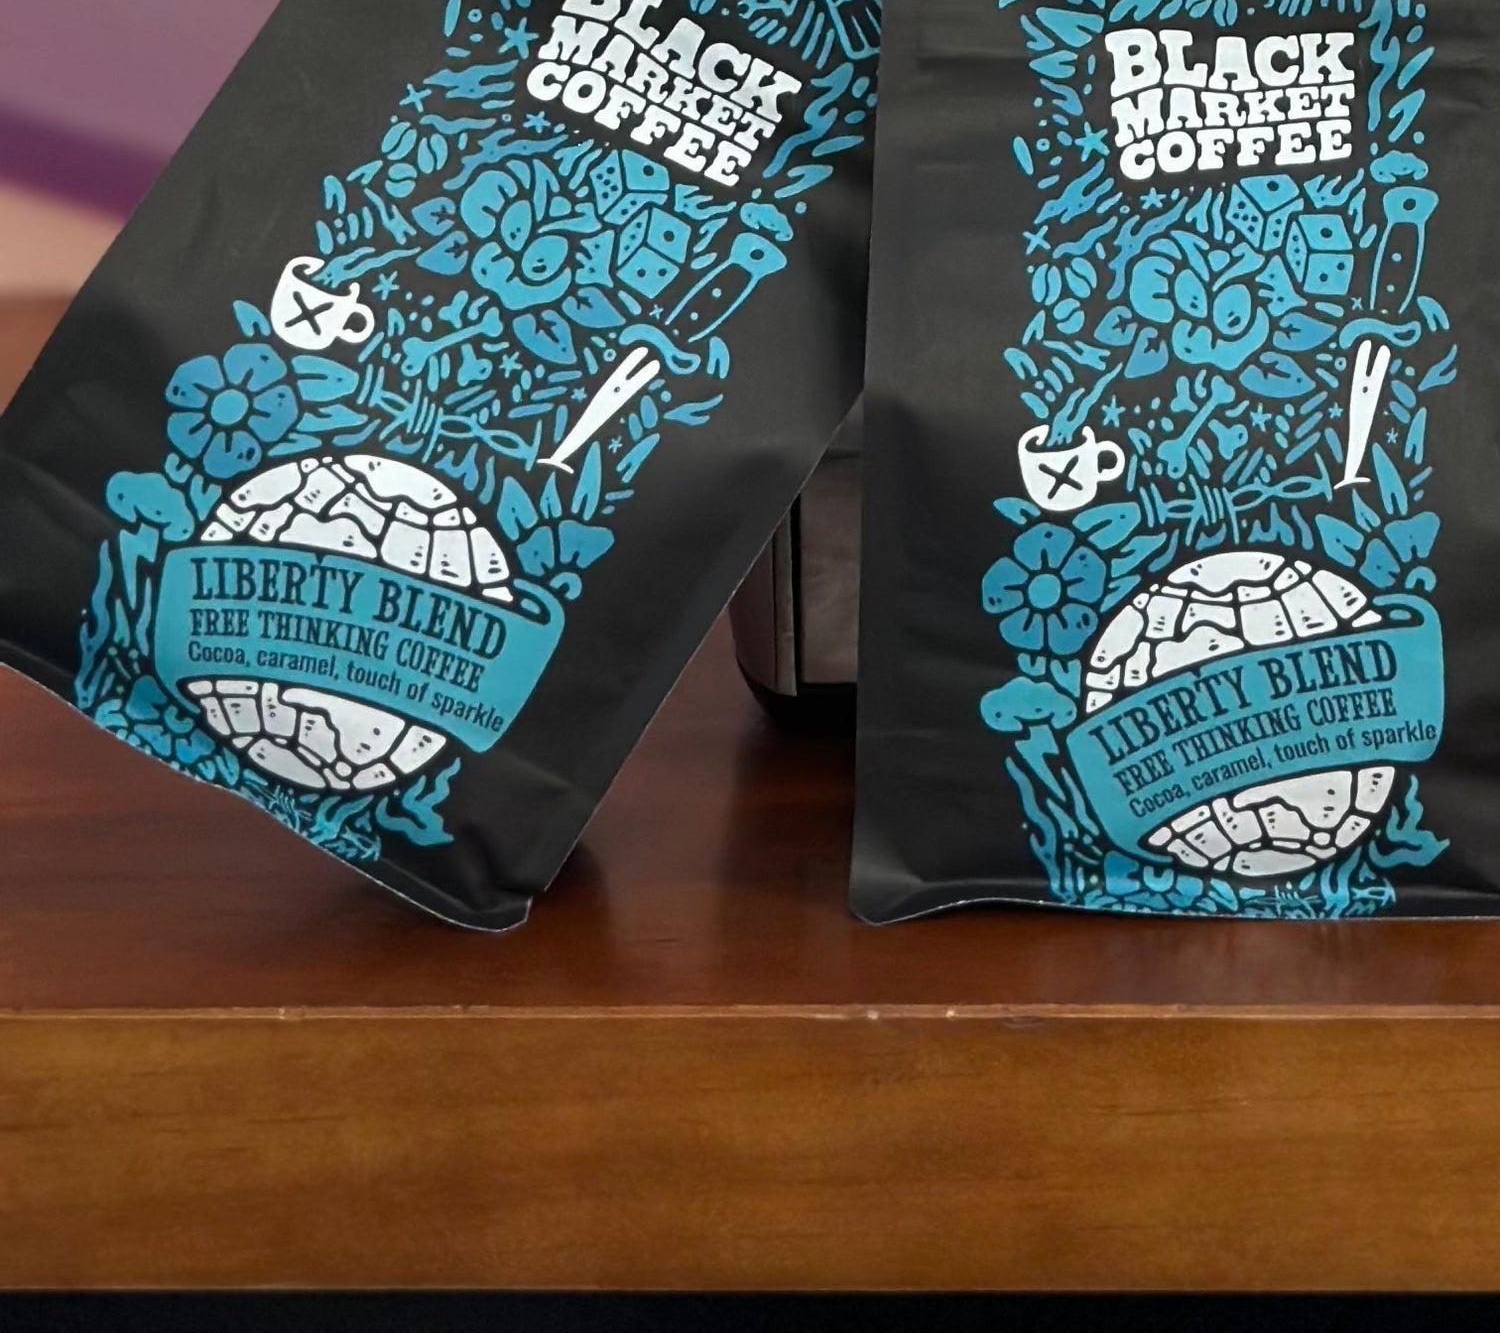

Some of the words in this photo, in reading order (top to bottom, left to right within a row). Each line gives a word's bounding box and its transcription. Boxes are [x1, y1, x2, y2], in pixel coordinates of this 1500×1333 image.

[538, 15, 776, 151] MARKET
[1104, 28, 1355, 97] BLACK
[526, 61, 752, 187] COFFEE
[1110, 83, 1355, 148] MARKET
[1119, 119, 1352, 180] COFFEE
[190, 557, 363, 614] LIBERTY
[373, 579, 507, 660] BLEND
[190, 608, 250, 637] FREE
[257, 611, 391, 661] THINKING
[396, 638, 486, 693] COFFEE
[188, 640, 251, 668] Cocoa,
[257, 651, 340, 681] caramel,
[346, 663, 402, 696] touch
[405, 677, 428, 703] of
[431, 688, 504, 733] sparkle
[1089, 666, 1255, 765] LIBERTY
[1258, 639, 1398, 700] BLEND
[1112, 748, 1175, 797] FREE
[1175, 704, 1302, 765] THINKING
[1306, 688, 1398, 725] COFFEE
[1129, 785, 1191, 818] Cocoa,
[1191, 749, 1273, 791] caramel,
[1273, 734, 1331, 763] touch
[1336, 727, 1358, 751] of
[1360, 719, 1437, 748] sparkle
